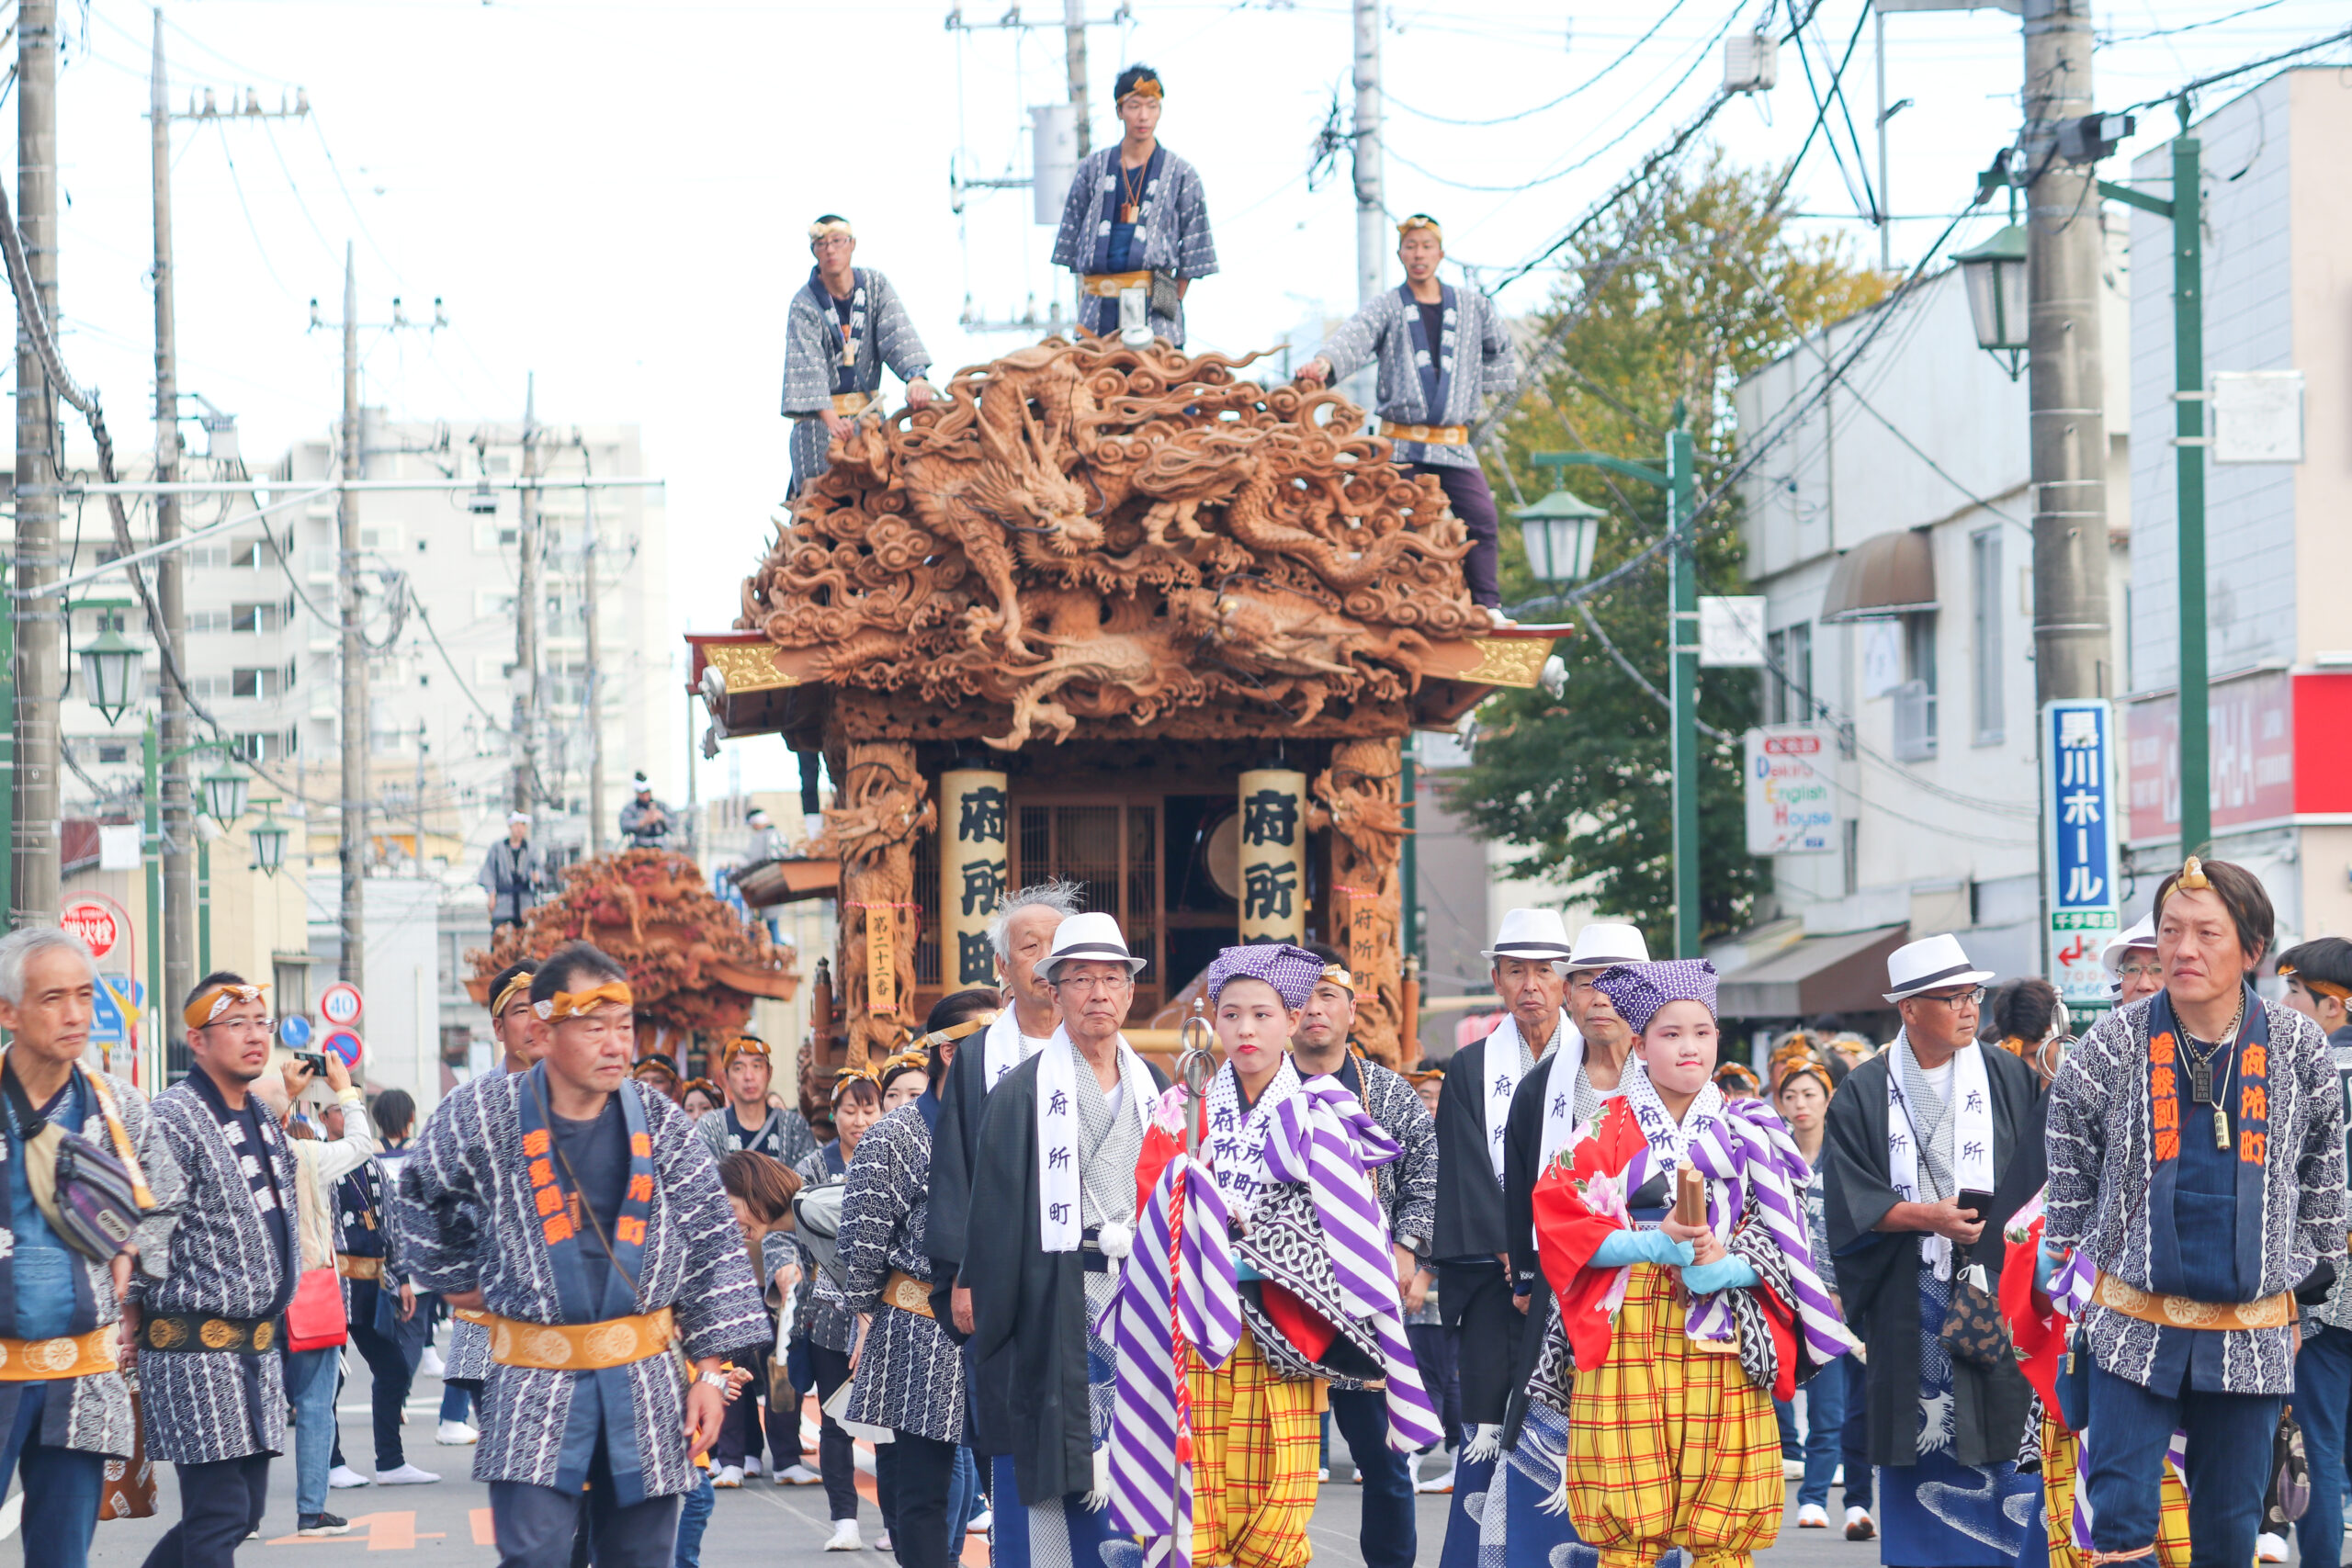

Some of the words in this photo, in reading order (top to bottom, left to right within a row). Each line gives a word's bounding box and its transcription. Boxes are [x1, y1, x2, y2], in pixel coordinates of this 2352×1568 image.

[1766, 779, 1827, 804] English
[1774, 803, 1832, 827] House
[2059, 710, 2104, 903] 黒川ホール
[1243, 789, 1298, 946] 府所
[1353, 907, 1374, 990] 府所町
[330, 995, 354, 1015] 40
[1962, 1089, 1985, 1167] 府所
[2240, 1041, 2267, 1167] 府所町
[1046, 1089, 1072, 1226] 府所町
